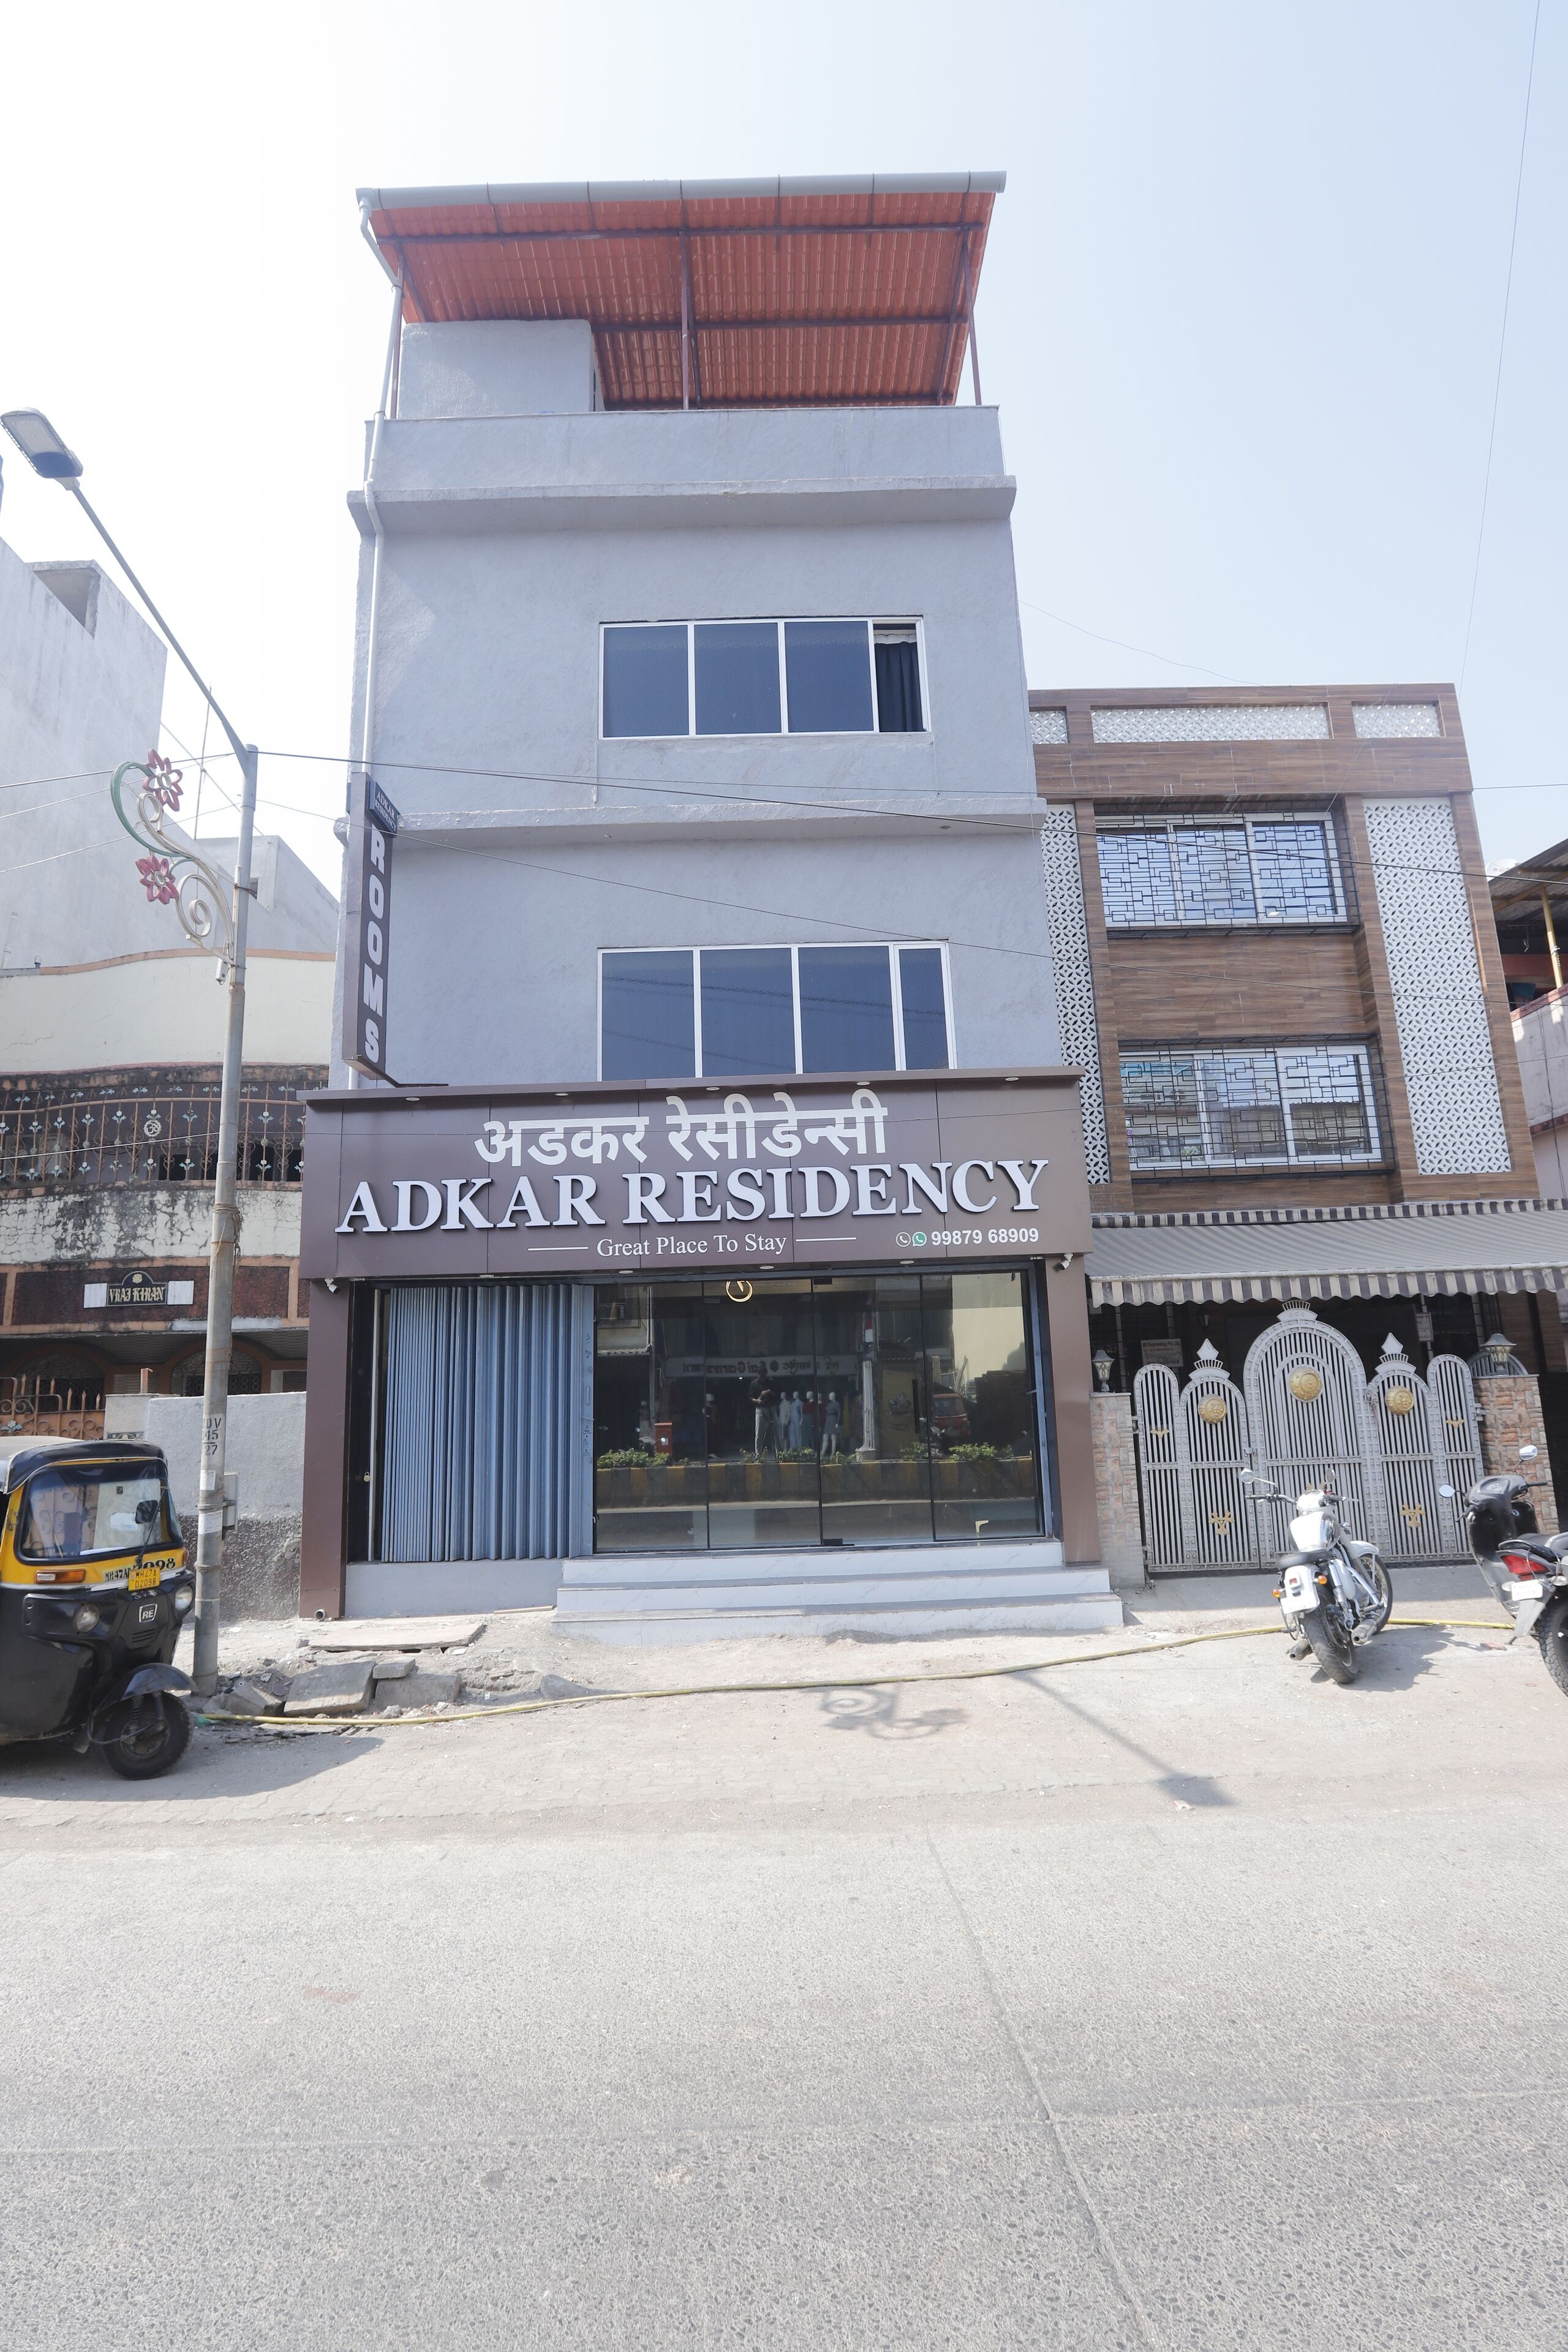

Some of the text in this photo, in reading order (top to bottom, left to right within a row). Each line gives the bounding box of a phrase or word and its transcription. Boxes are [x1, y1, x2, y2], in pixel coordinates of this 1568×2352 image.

[374, 798, 397, 832] RESIDENCY
[377, 791, 395, 821] ADKAR
[363, 823, 385, 1064] ROOMS
[473, 1088, 888, 1167] अडकर रेसीडेन्सी
[334, 1159, 1049, 1234] ADKAR RESIDENCY
[597, 1233, 788, 1257] Great Place To Stay
[931, 1227, 1039, 1246] 99879 68909
[109, 1286, 165, 1303] VRAJ KIRAN
[203, 1417, 222, 1429] DV
[202, 1444, 218, 1456] 27
[135, 1567, 157, 1579] MH47A
[142, 1610, 154, 1619] RE
